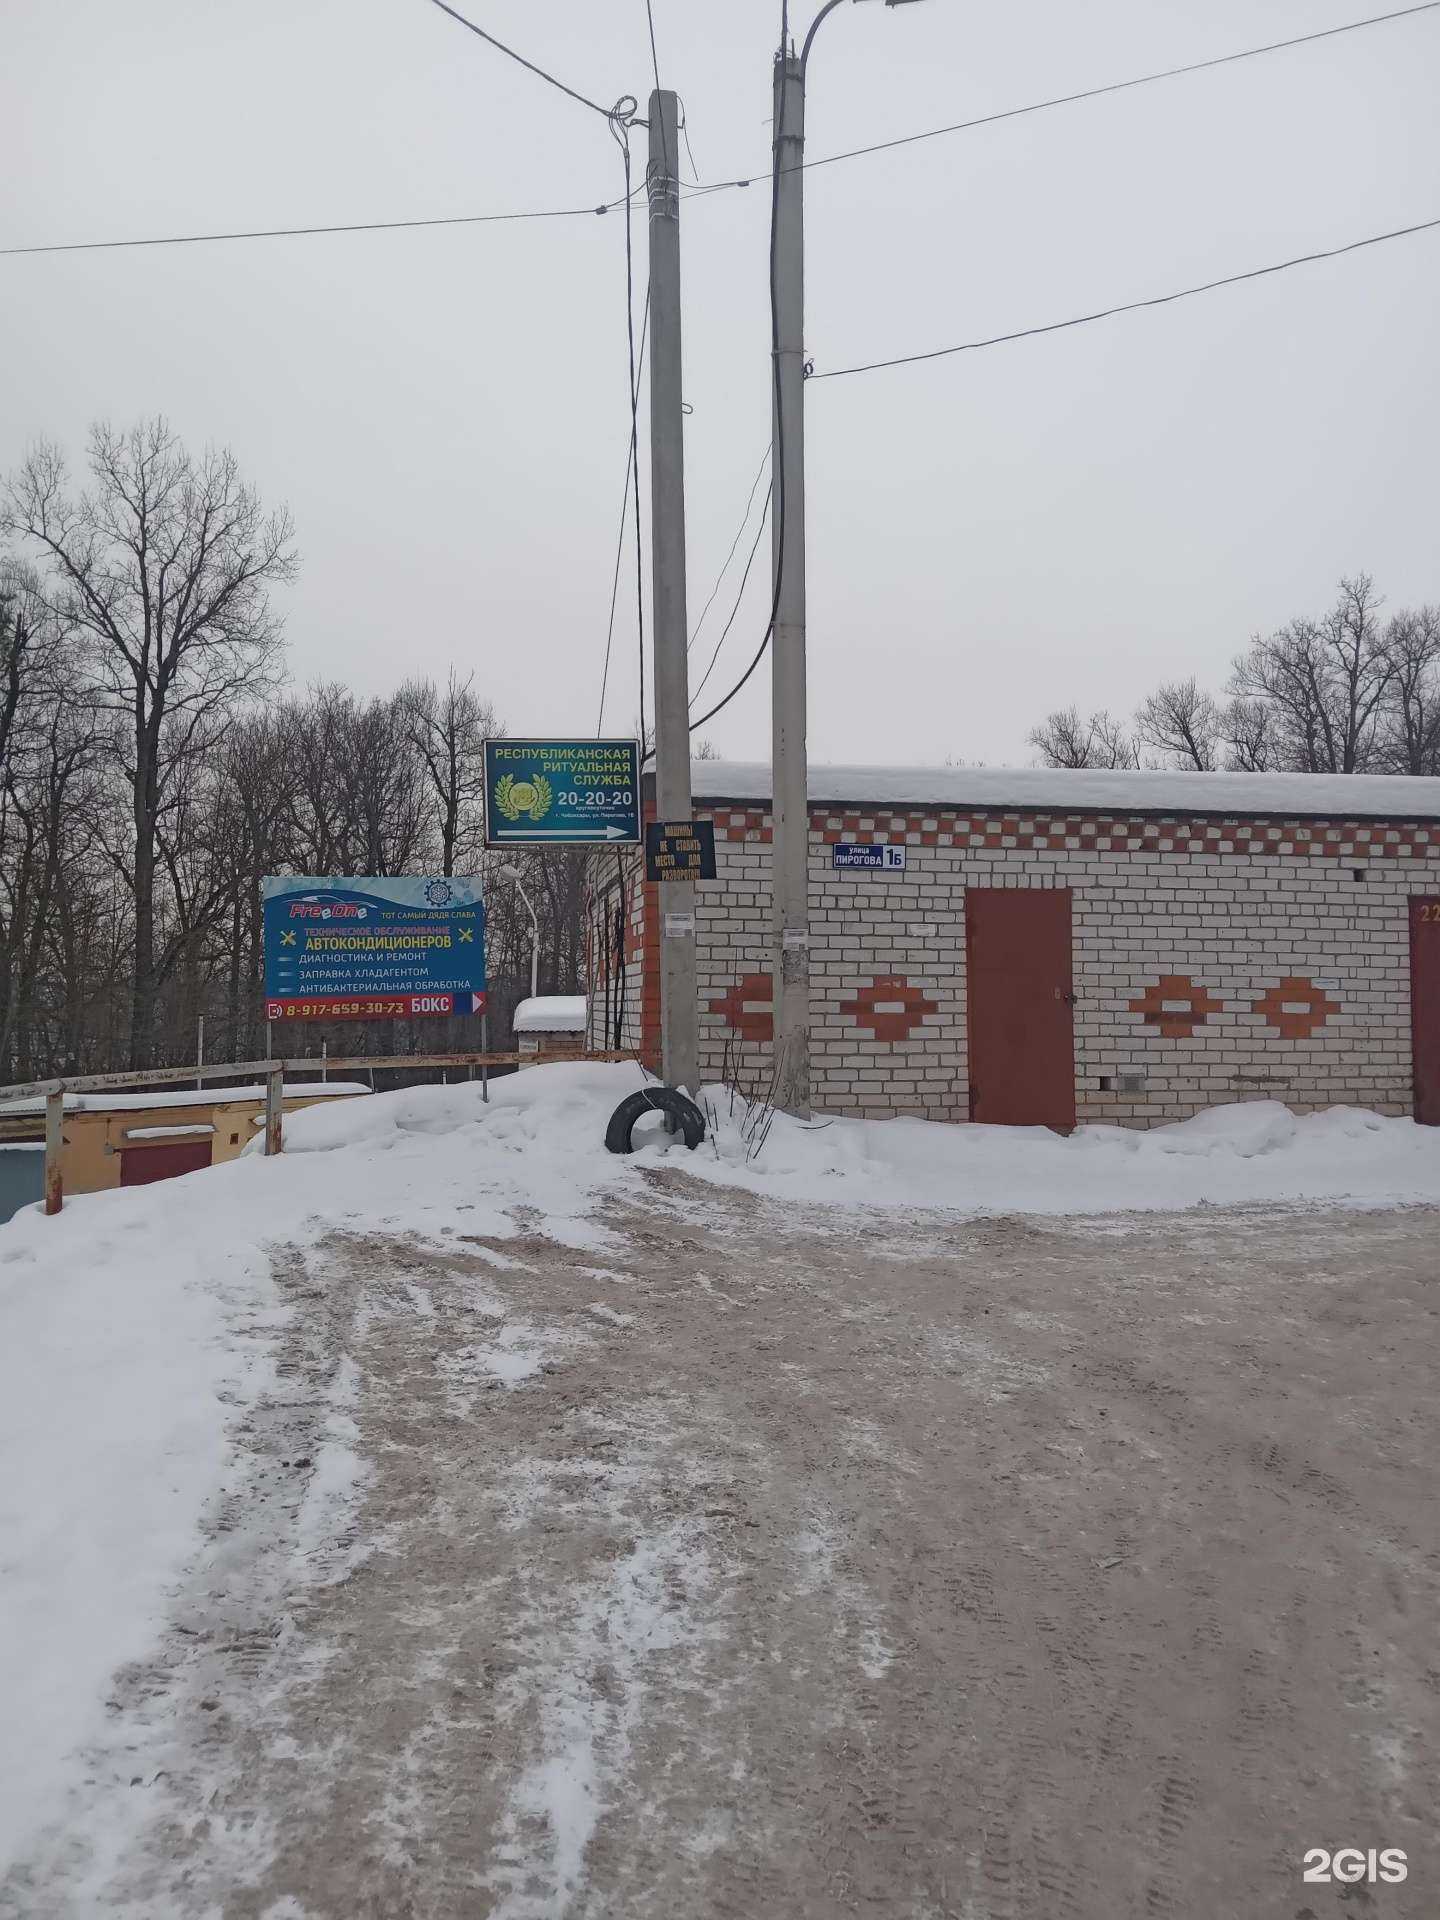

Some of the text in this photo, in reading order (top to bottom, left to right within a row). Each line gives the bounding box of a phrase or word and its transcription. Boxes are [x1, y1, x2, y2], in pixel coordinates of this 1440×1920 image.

[495, 748, 630, 759] РЕСПУБЛИКАНСКАЯ
[543, 762, 631, 772] РИТУАЛЬНАЯ
[574, 775, 631, 786] СЛУЖБА
[558, 791, 632, 805] 20-20-20
[660, 840, 701, 852] НЕ СТАВИТЬ
[849, 847, 869, 855] улица
[655, 855, 675, 867] МЕСТО
[835, 848, 902, 866] ПИРОГОВА 1Б
[397, 911, 428, 919] САМЫЙ
[428, 911, 450, 919] ДЯДЯ
[451, 911, 476, 919] СЛАВА
[304, 926, 450, 936] ТЕХНИЧЕСКОЕ ОБСЛУЖИВАНИЕ
[305, 935, 452, 951] АВТОКОНДИЦИОНЕРОВ
[299, 952, 427, 964] ДИАГНОСТИКА И РЕМОНТ
[299, 968, 429, 979] ЗАПРАВКА ХЛАДАГЕНТОМ
[299, 980, 471, 993] АНТИБАКТЕРИАЛЬНАЯ ОБРАБОТКА
[287, 1001, 404, 1016] 8-917-659-30-73
[411, 997, 450, 1013] БОКС
